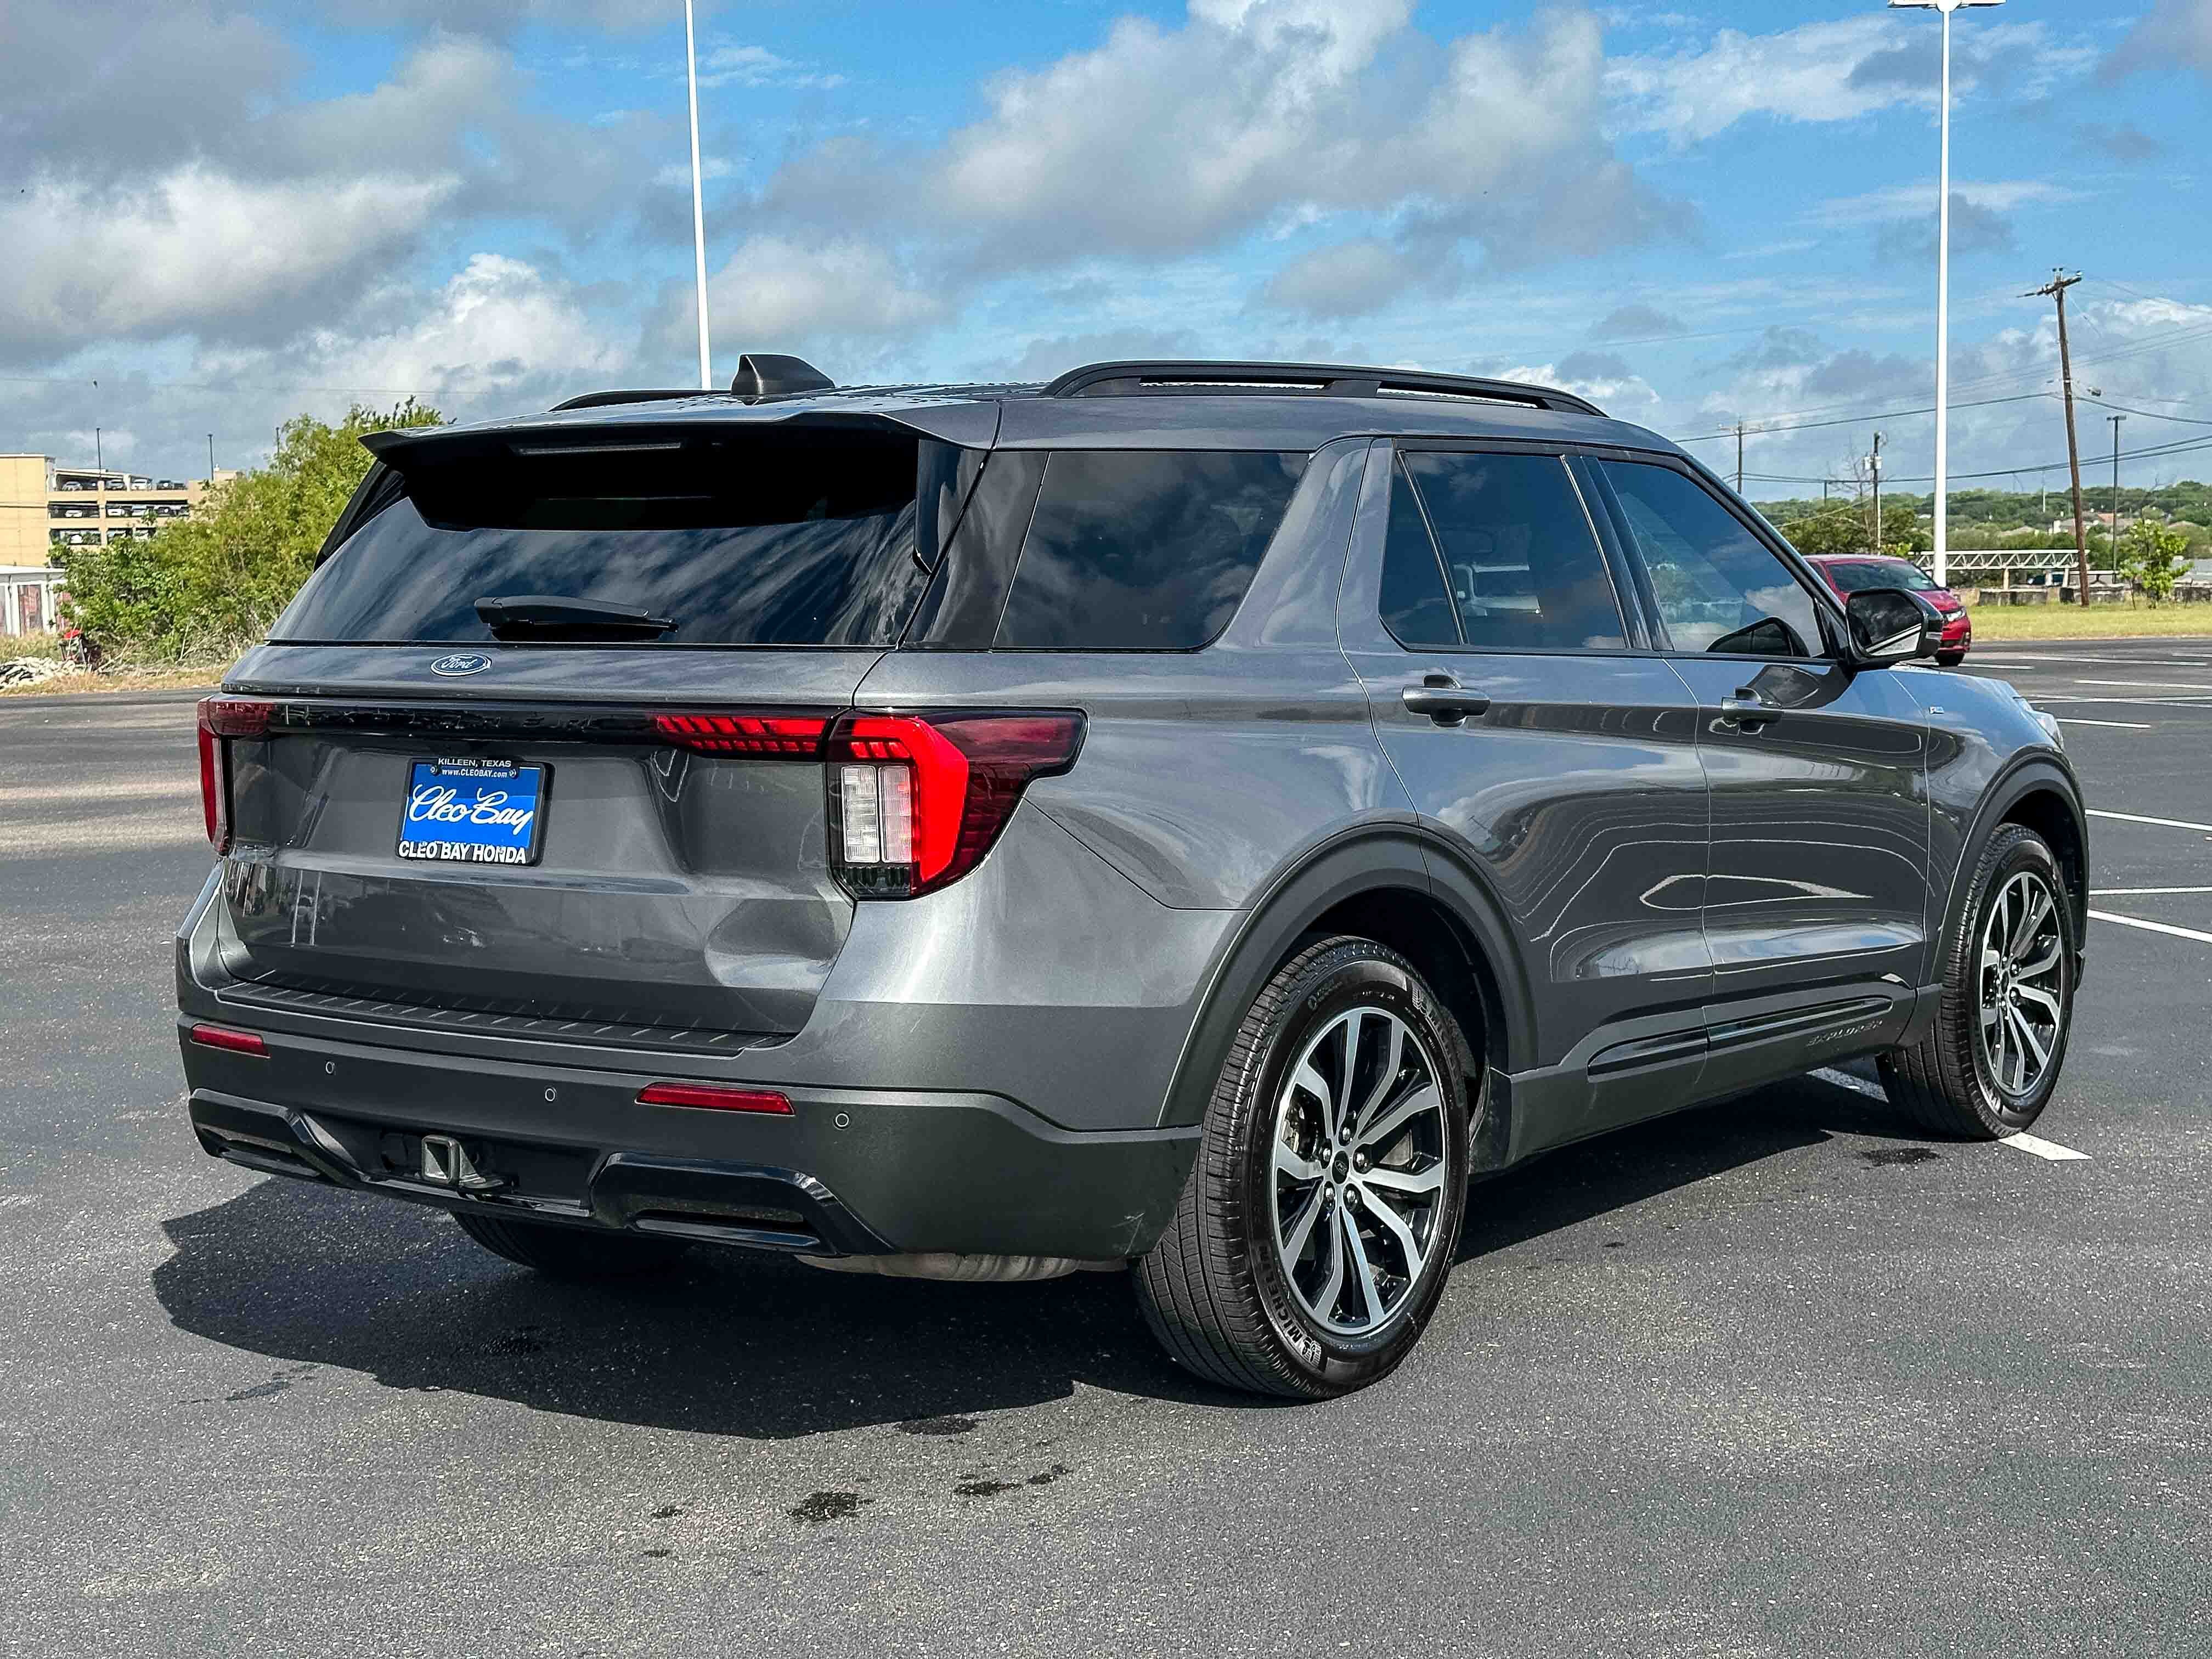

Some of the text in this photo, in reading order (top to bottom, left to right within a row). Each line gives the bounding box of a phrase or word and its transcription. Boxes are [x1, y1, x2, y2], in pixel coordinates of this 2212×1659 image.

[441, 656, 478, 668] Ford
[438, 758, 478, 767] KILLEEN,
[442, 769, 507, 778] www.CLEOBAY.com
[409, 784, 534, 836] Cleo Bay
[399, 841, 526, 864] CLEO BAY HONDA
